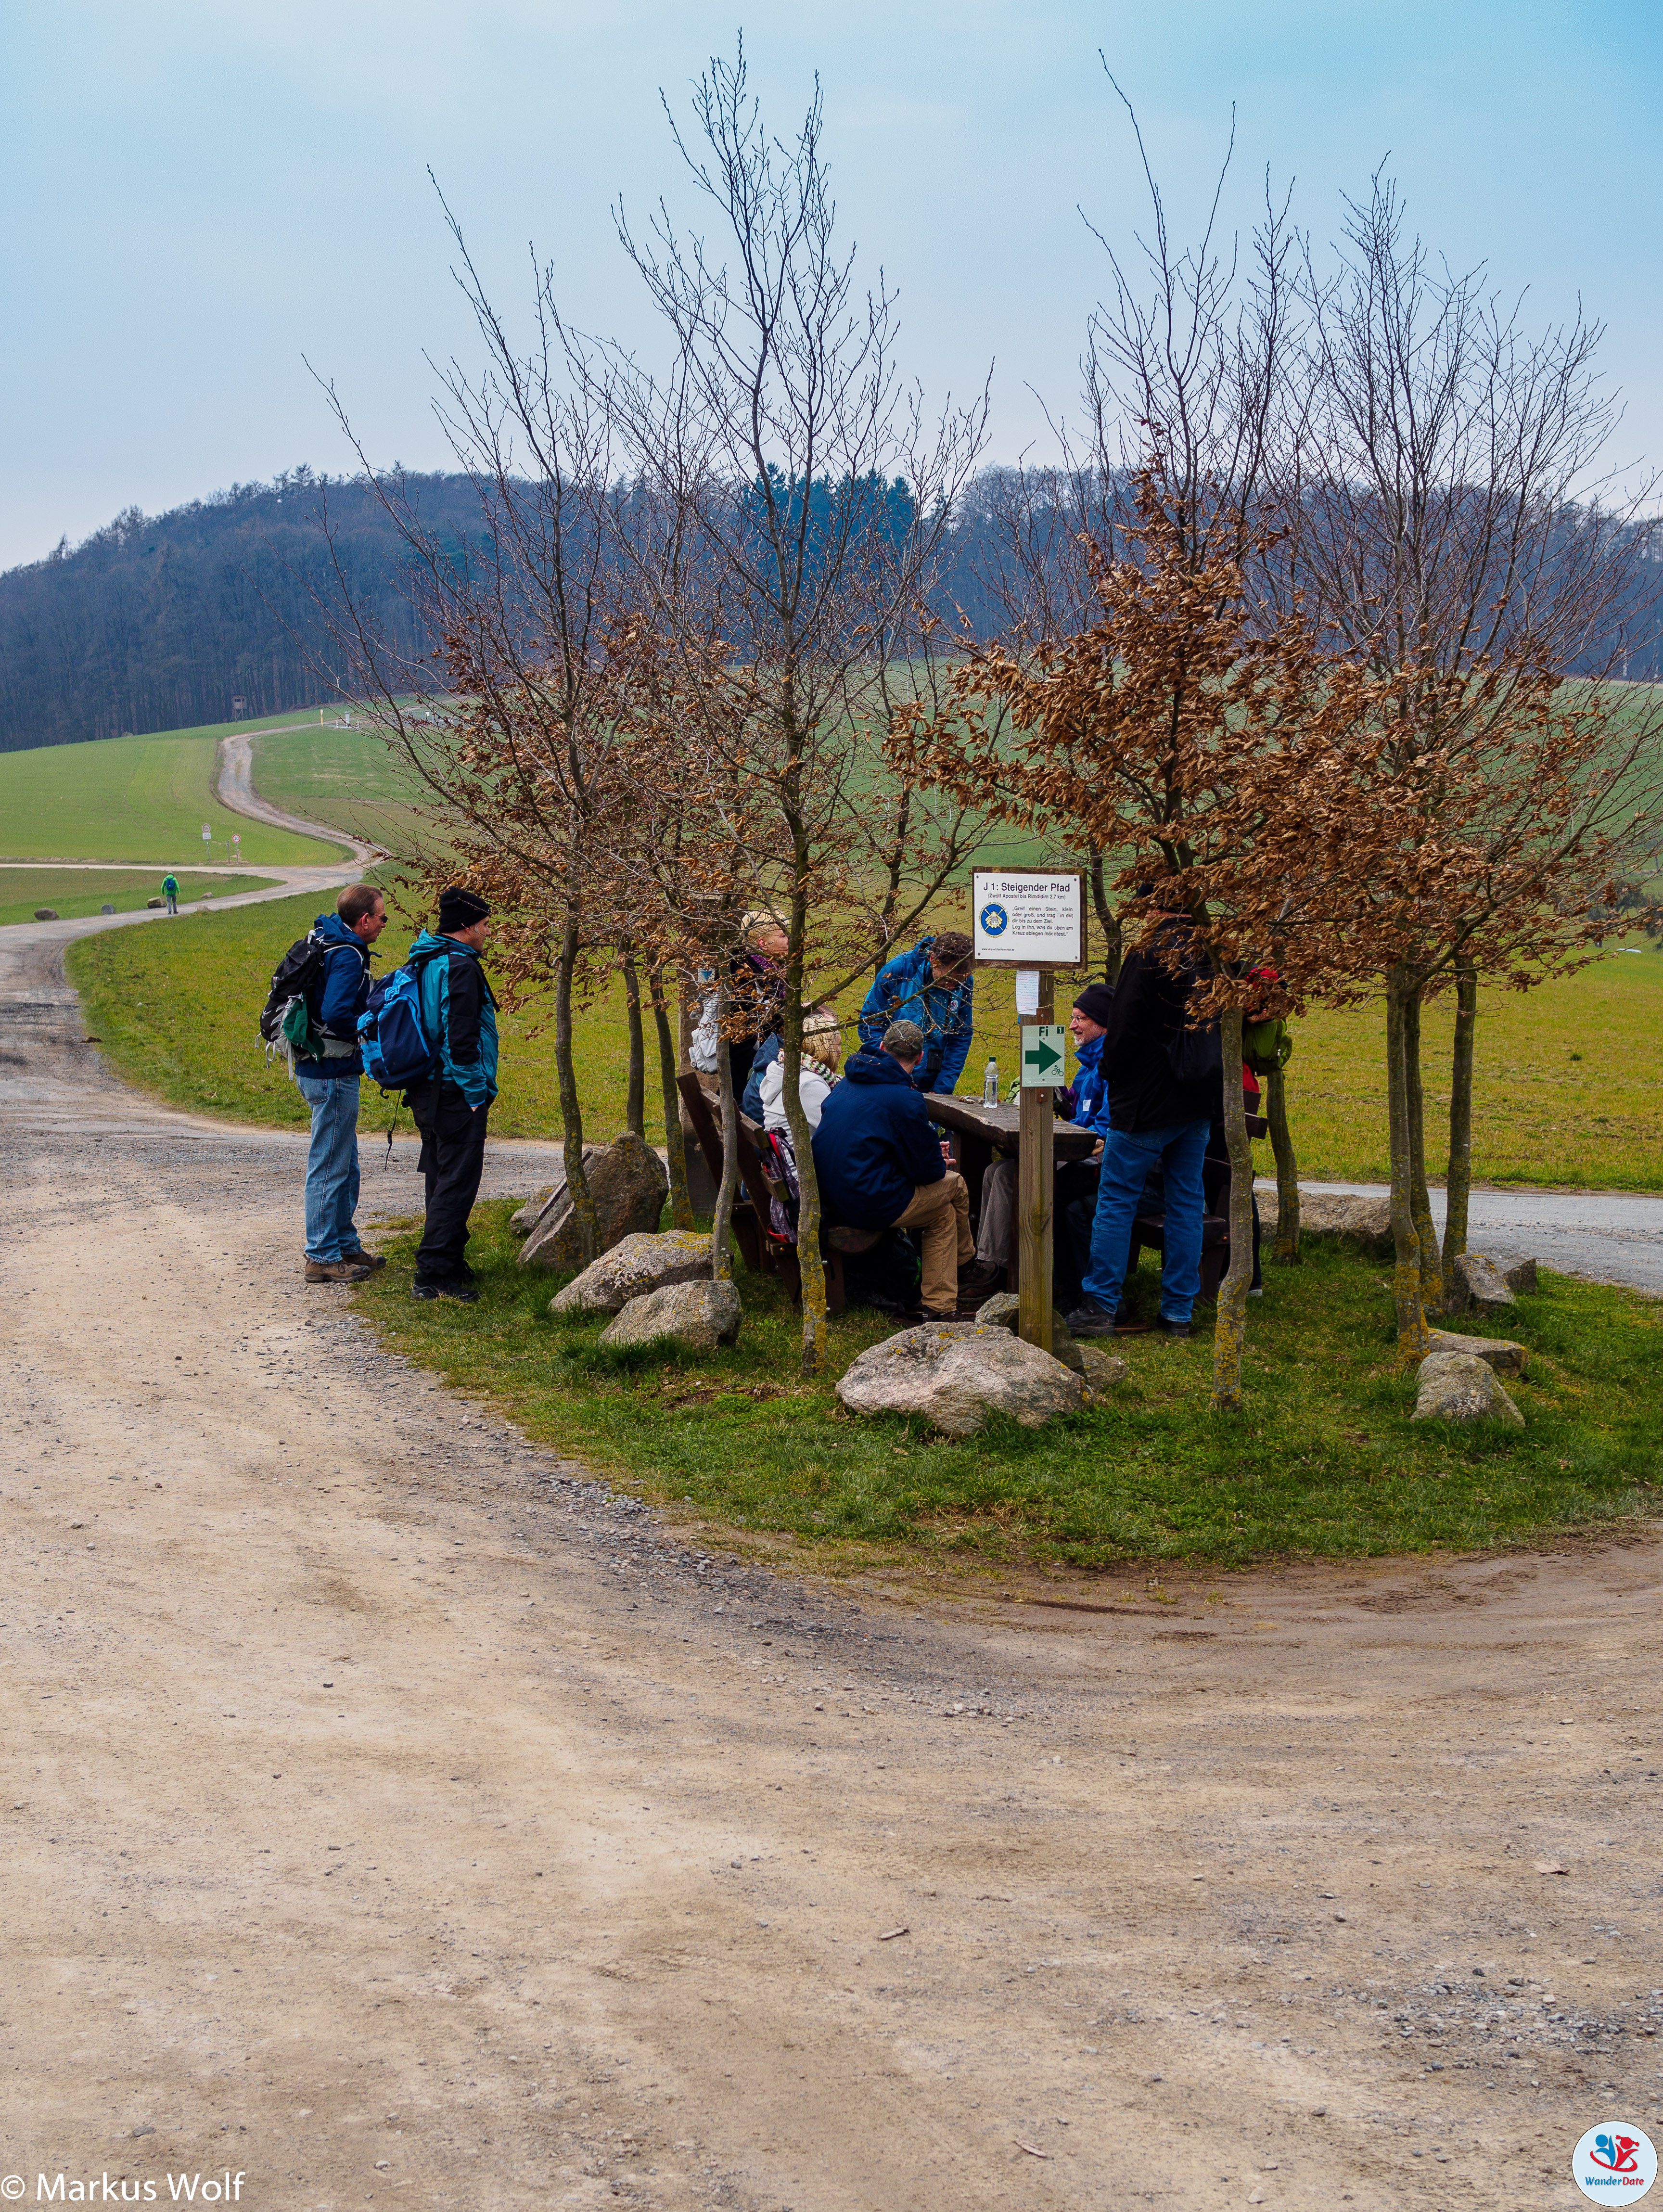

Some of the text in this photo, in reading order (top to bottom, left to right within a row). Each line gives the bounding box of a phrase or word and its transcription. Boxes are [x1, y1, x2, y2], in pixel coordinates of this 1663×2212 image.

[983, 882, 1070, 893] J 1: Steigender Pfad
[1038, 1025, 1049, 1037] Fi
